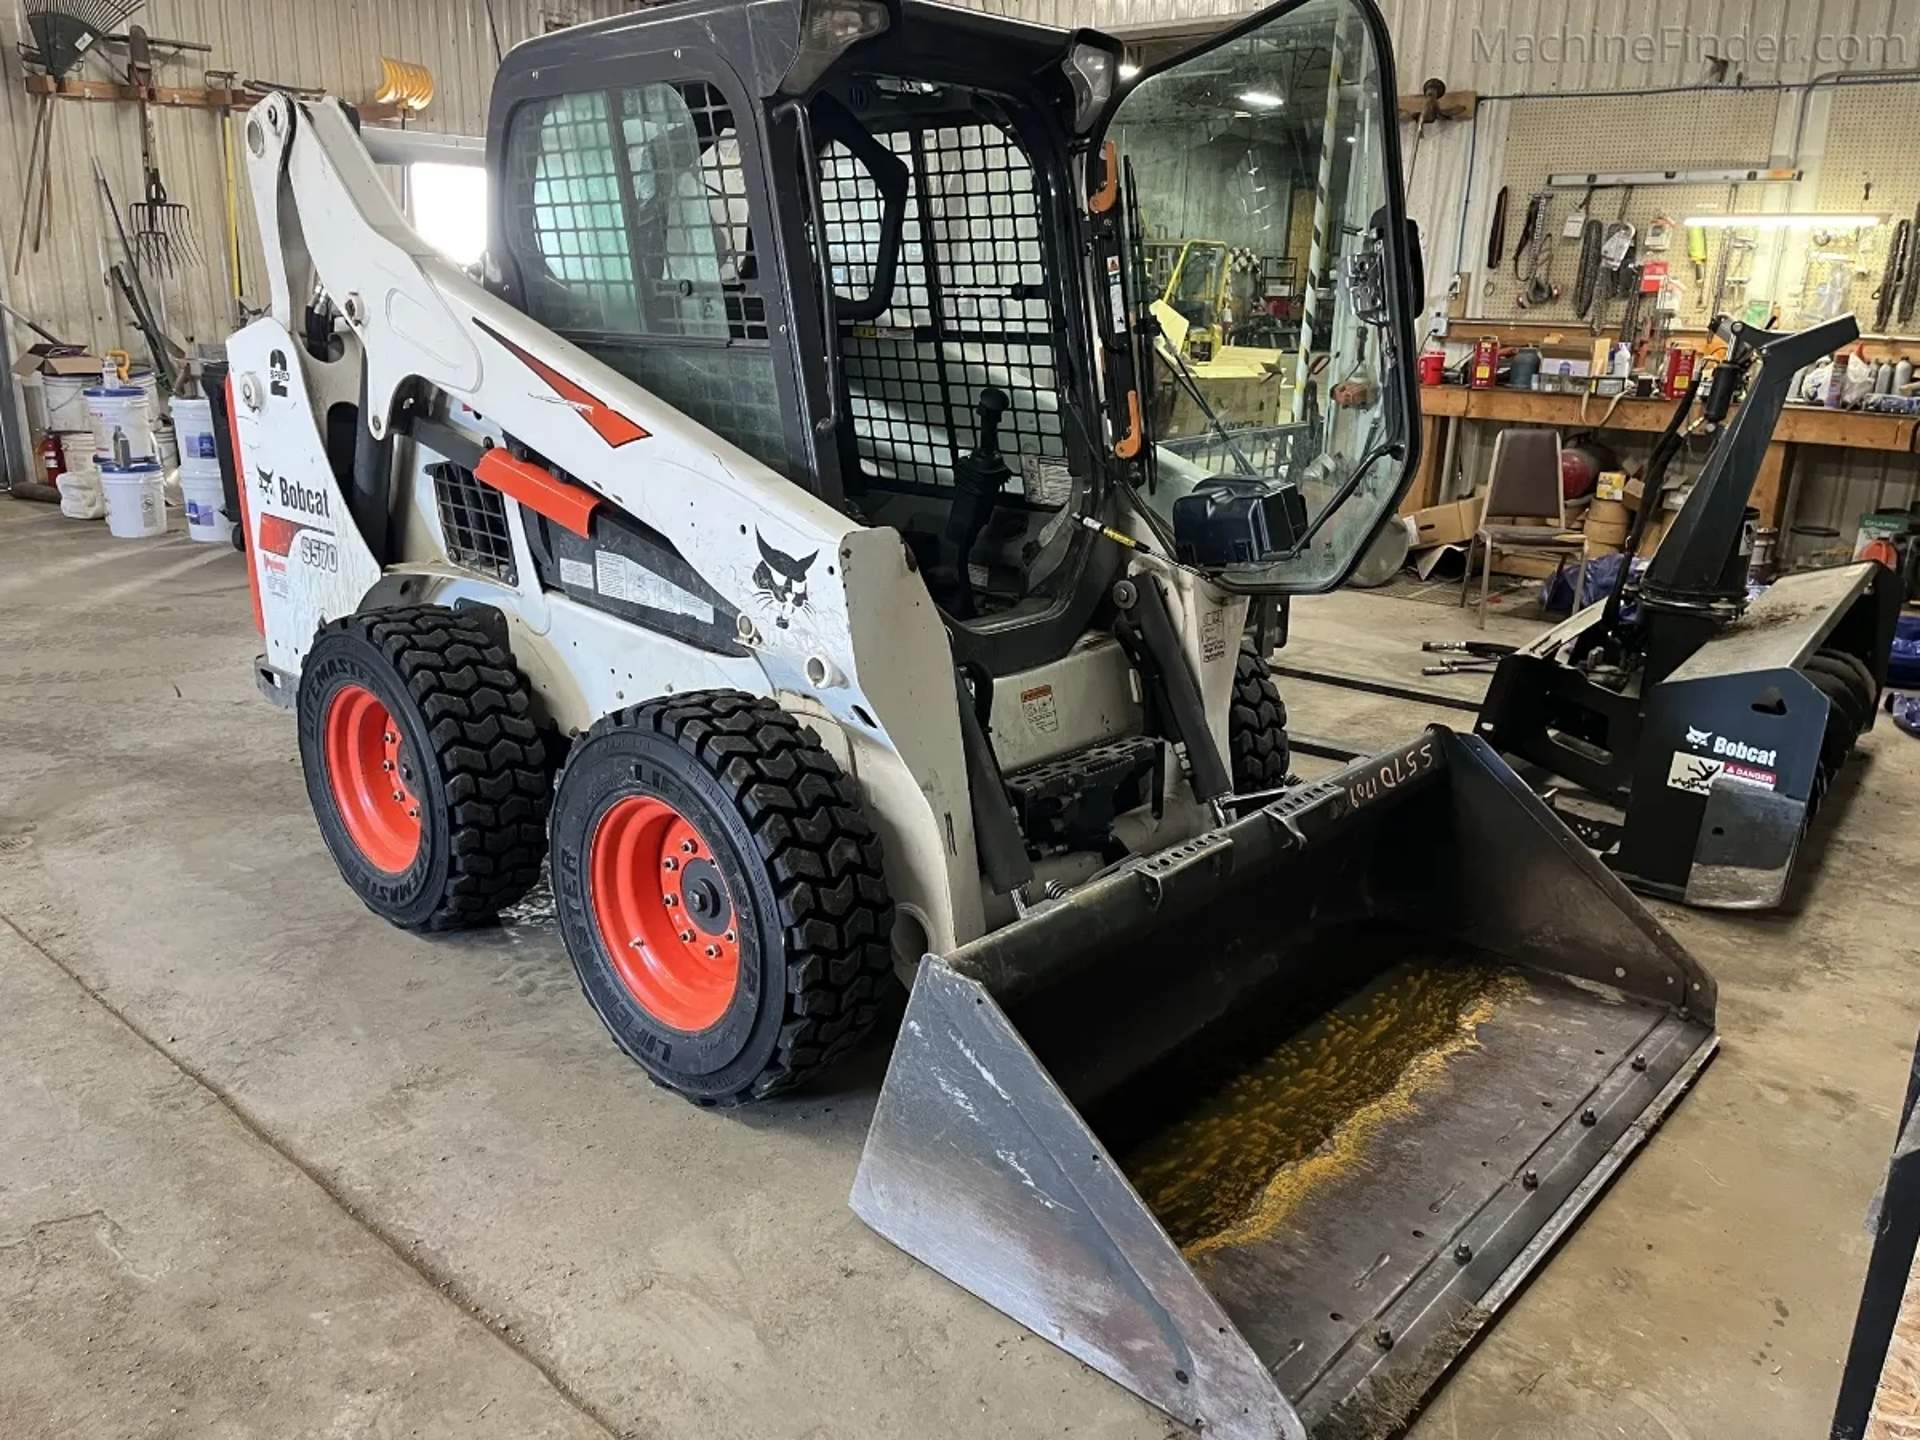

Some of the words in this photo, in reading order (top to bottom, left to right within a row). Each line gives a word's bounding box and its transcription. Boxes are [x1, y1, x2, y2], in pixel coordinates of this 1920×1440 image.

[278, 476, 330, 519] Bobcat
[300, 535, 338, 574] S570
[1713, 735, 1777, 767] Bobcat
[1735, 767, 1774, 784] DANGER
